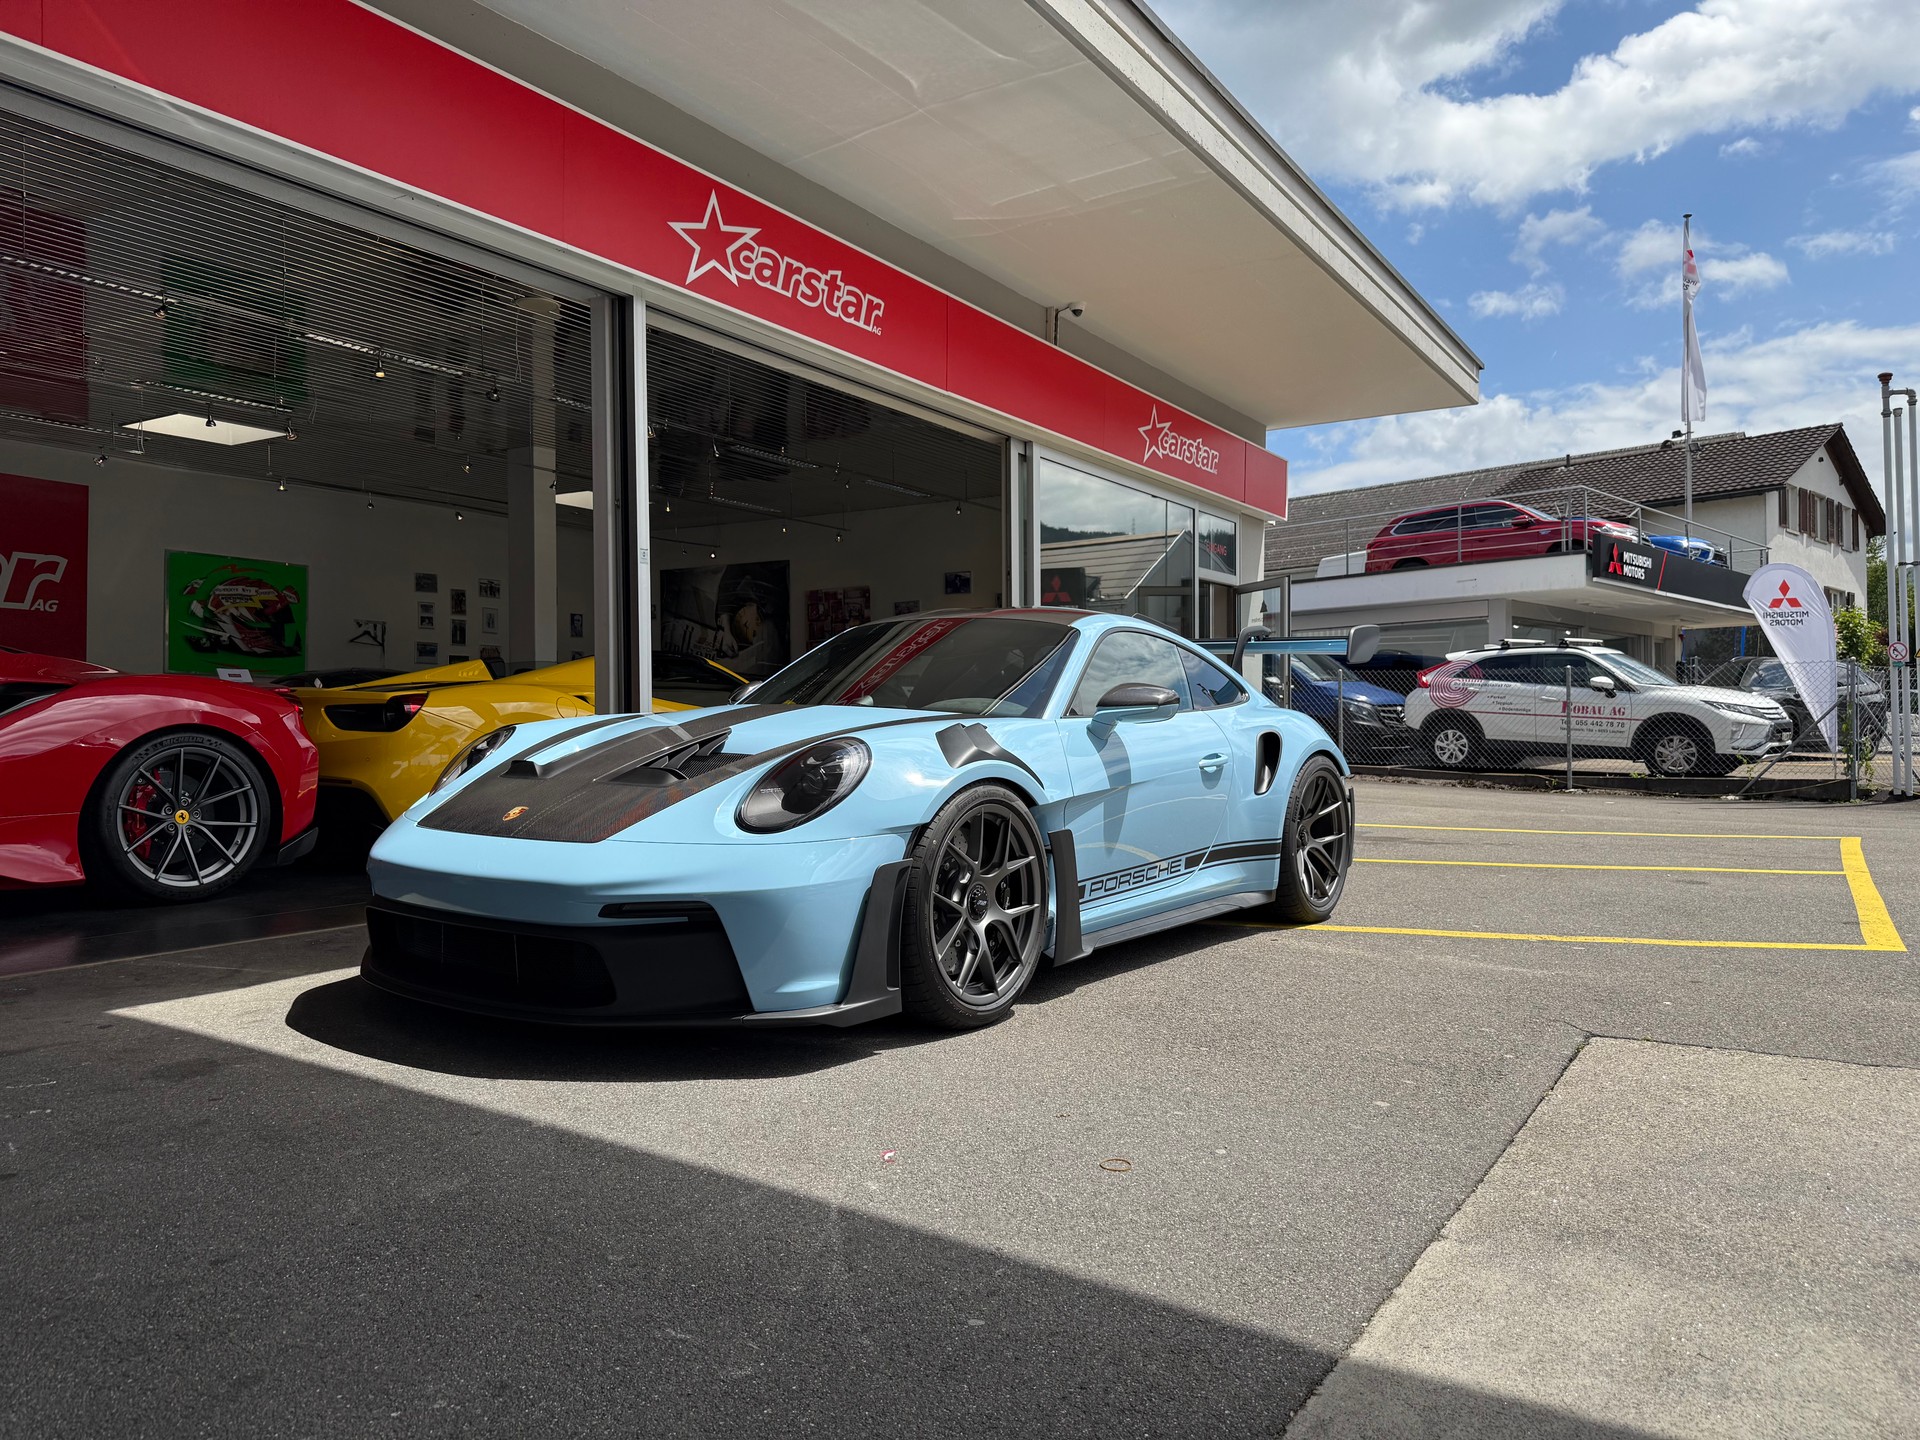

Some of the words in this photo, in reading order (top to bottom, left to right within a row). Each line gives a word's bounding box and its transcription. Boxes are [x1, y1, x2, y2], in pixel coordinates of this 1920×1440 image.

[726, 239, 885, 332] carstar
[871, 326, 882, 336] AG
[1158, 429, 1219, 474] carstar
[1623, 551, 1652, 569] MITSUBISHI
[1623, 564, 1645, 580] MOTORS
[30, 599, 59, 612] AG
[1609, 706, 1626, 717] AG
[162, 736, 205, 747] MICHELIN
[1088, 858, 1183, 897] PORSCHE
